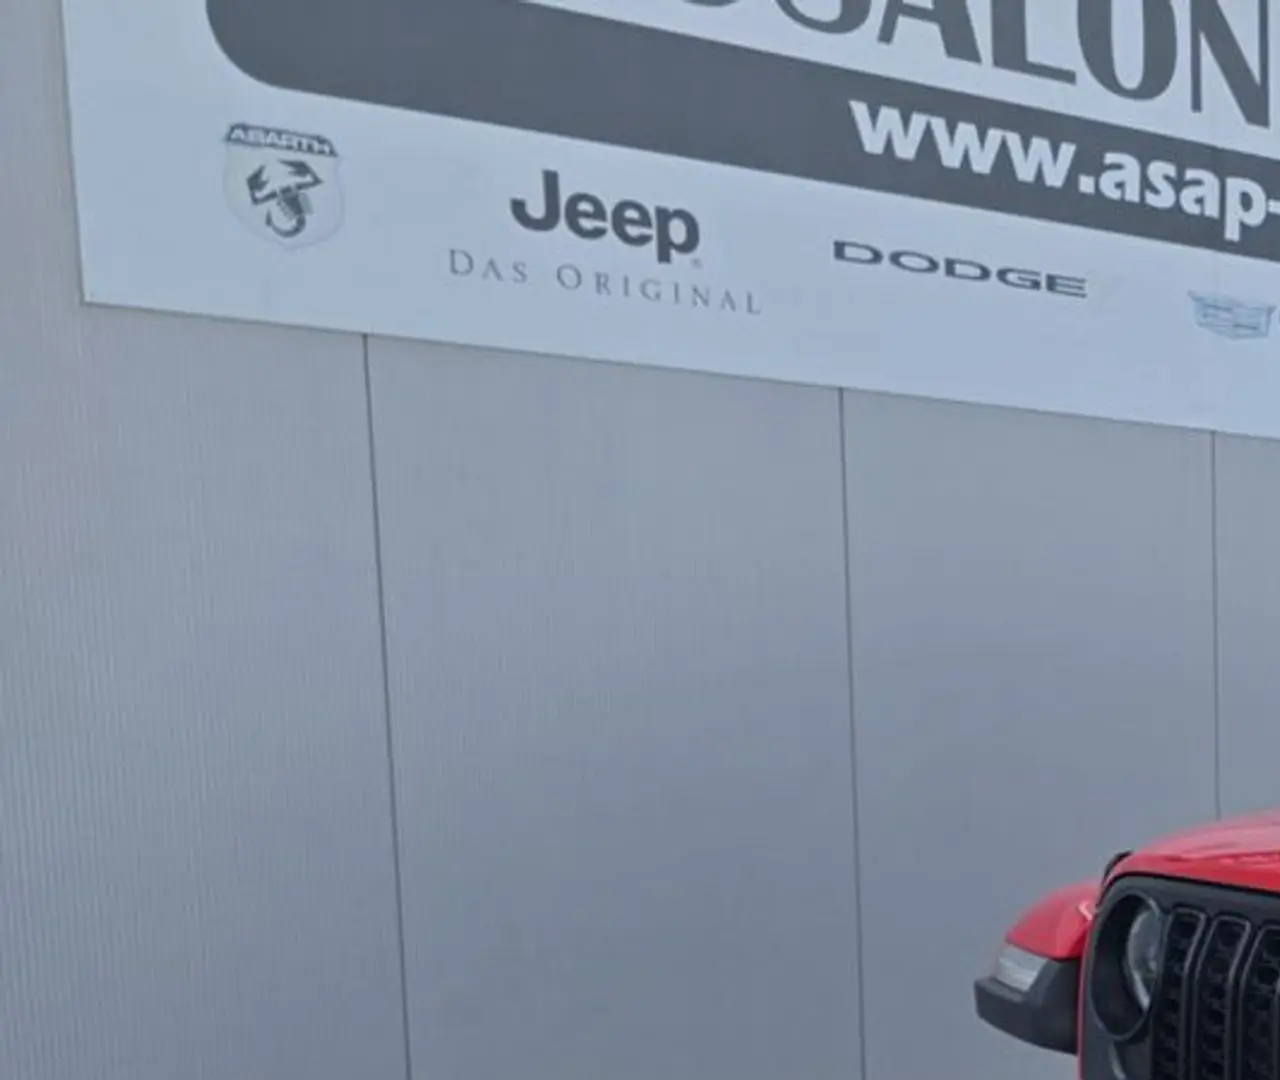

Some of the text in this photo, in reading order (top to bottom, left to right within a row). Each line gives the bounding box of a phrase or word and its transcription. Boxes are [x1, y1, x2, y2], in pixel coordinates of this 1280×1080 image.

[682, 0, 1271, 130] LON
[229, 126, 334, 155] ABARTH
[510, 169, 700, 264] Jeep
[449, 249, 763, 315] DAS ORIGINAL
[833, 240, 1088, 299] DODGE
